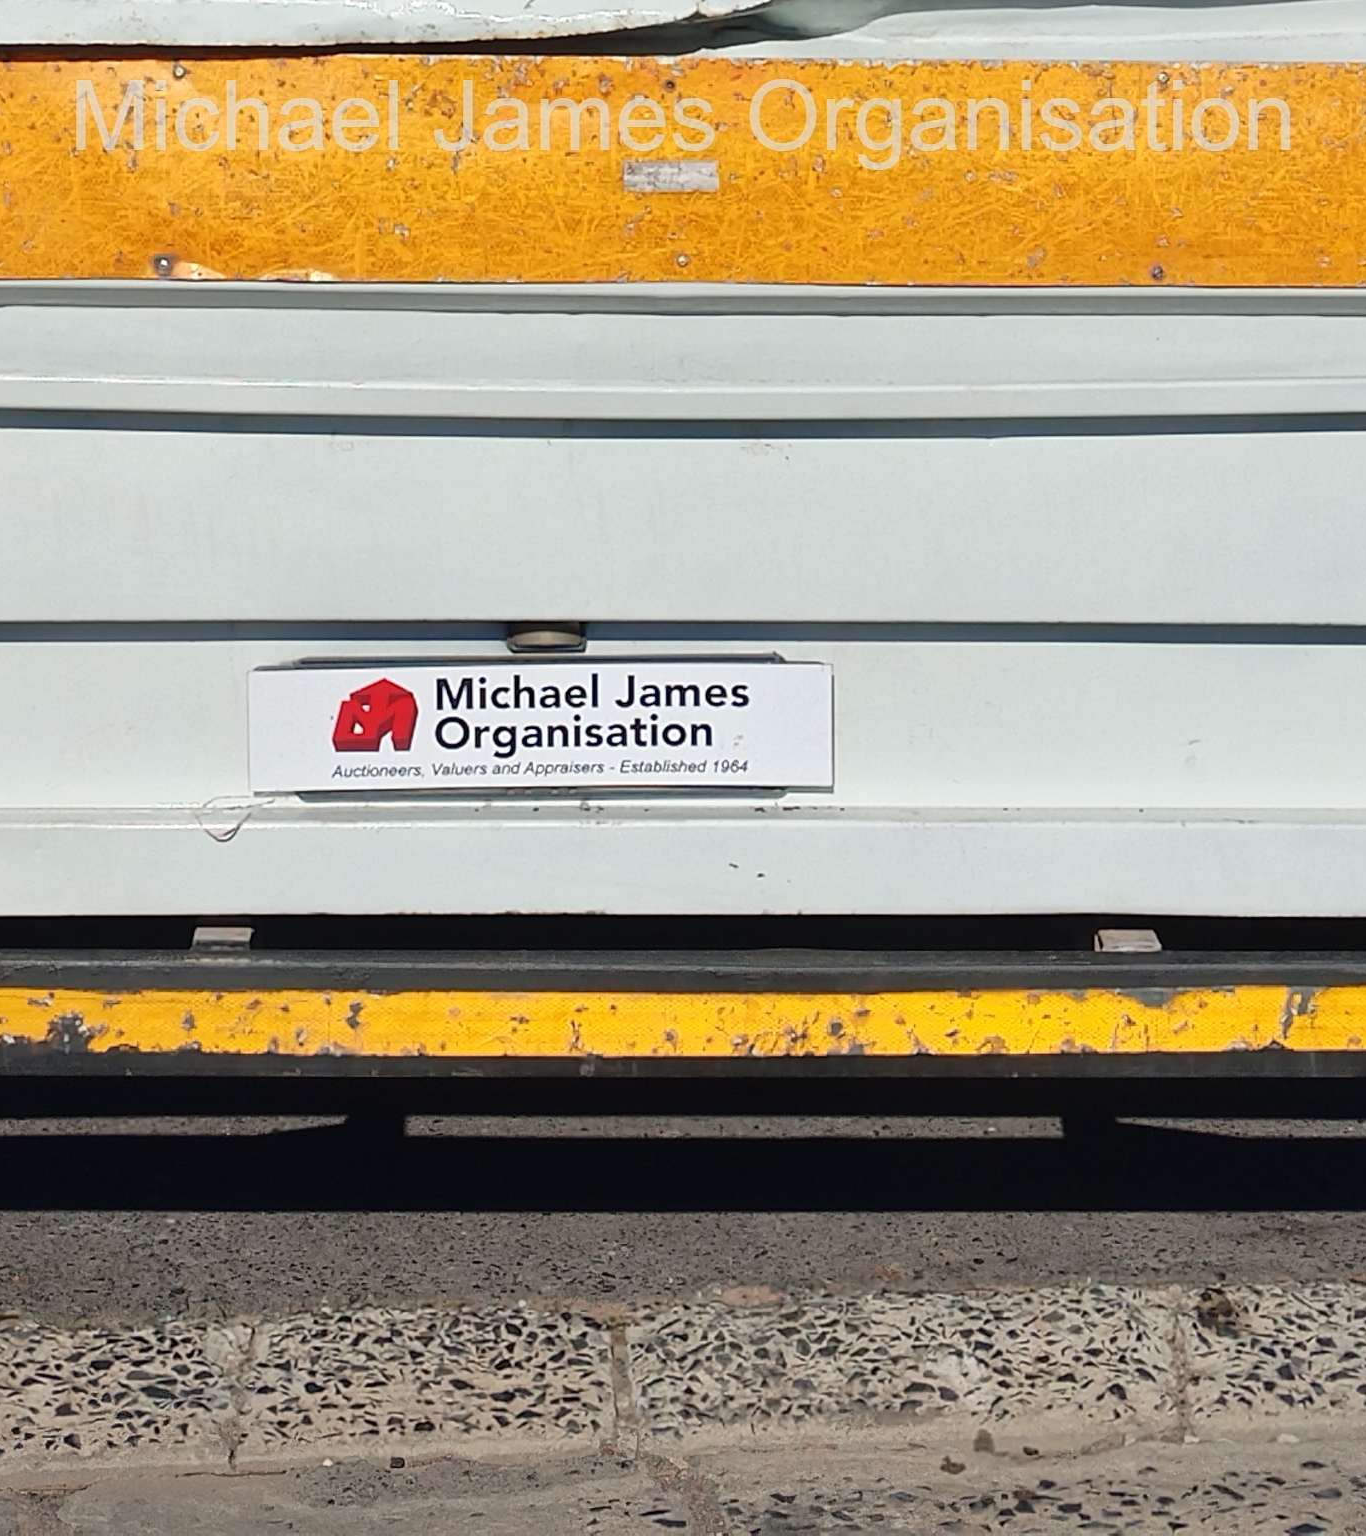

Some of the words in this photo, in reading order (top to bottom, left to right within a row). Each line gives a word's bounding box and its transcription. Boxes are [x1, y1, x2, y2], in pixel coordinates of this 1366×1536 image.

[435, 673, 599, 711] Michael
[614, 675, 751, 708] James
[435, 713, 714, 759] Organisation
[331, 764, 425, 780] Auctioneers,
[432, 762, 488, 777] Valuers
[492, 762, 521, 776] and
[523, 761, 605, 778] Appraisers
[619, 759, 707, 774] Established
[713, 759, 749, 775] 1964
